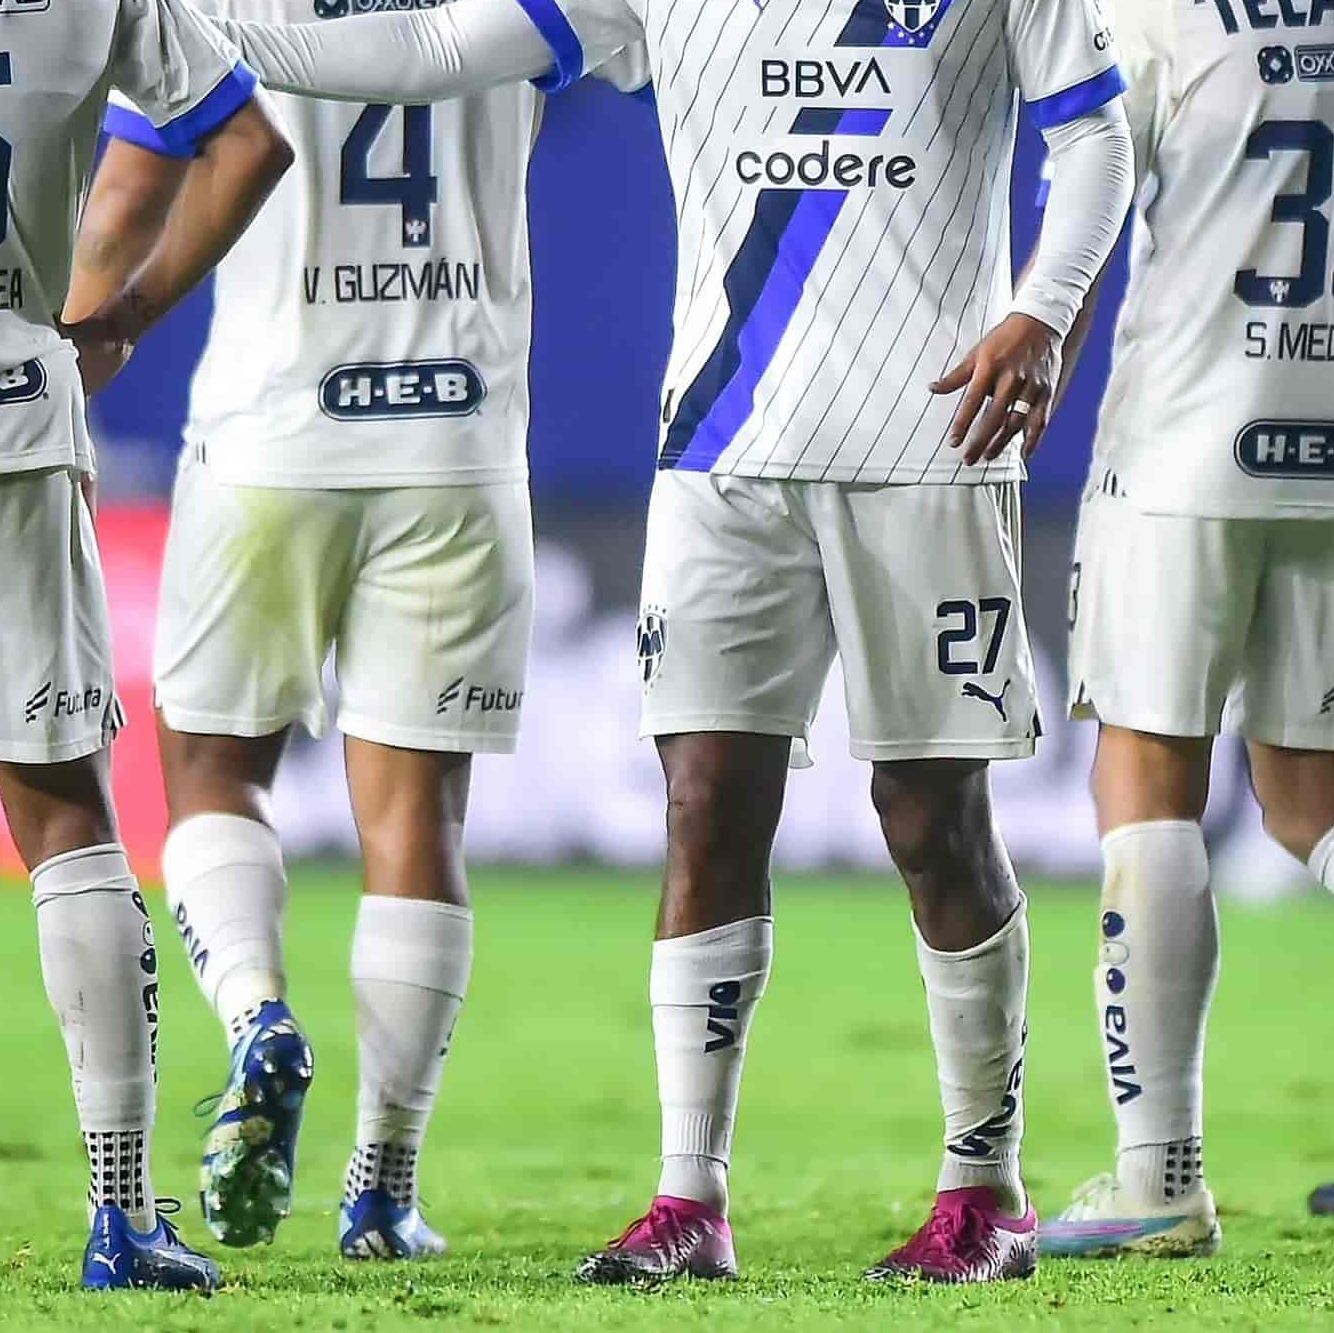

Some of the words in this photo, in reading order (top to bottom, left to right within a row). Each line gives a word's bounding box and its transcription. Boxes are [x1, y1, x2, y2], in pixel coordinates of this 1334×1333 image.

[761, 56, 892, 98] BBVA
[340, 104, 437, 248] 4
[736, 140, 916, 189] codere
[304, 266, 327, 304] V.
[334, 257, 479, 302] GUZMÁN
[1244, 322, 1271, 360] S.
[936, 598, 1011, 674] 27
